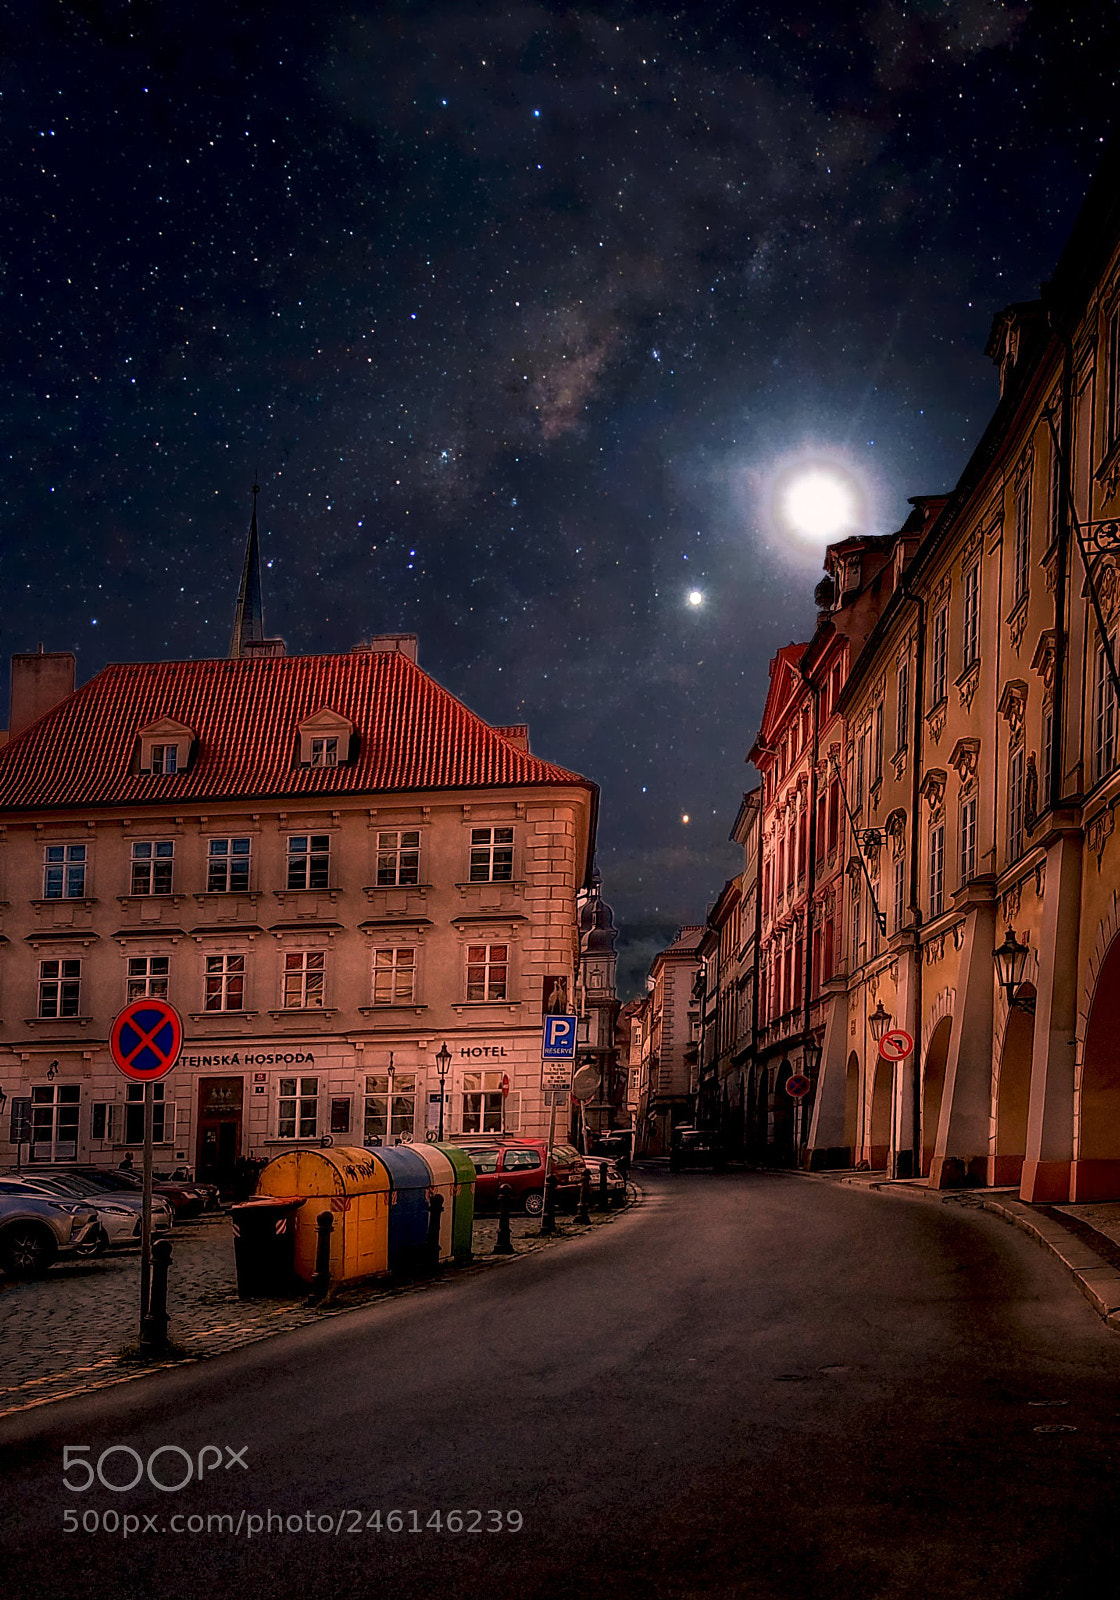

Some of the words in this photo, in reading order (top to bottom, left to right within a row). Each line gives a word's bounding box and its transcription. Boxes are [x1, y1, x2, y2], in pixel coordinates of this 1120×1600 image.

[550, 1020, 570, 1046] P
[245, 1052, 315, 1065] HOSPODA
[461, 1046, 508, 1058] HOTEL
